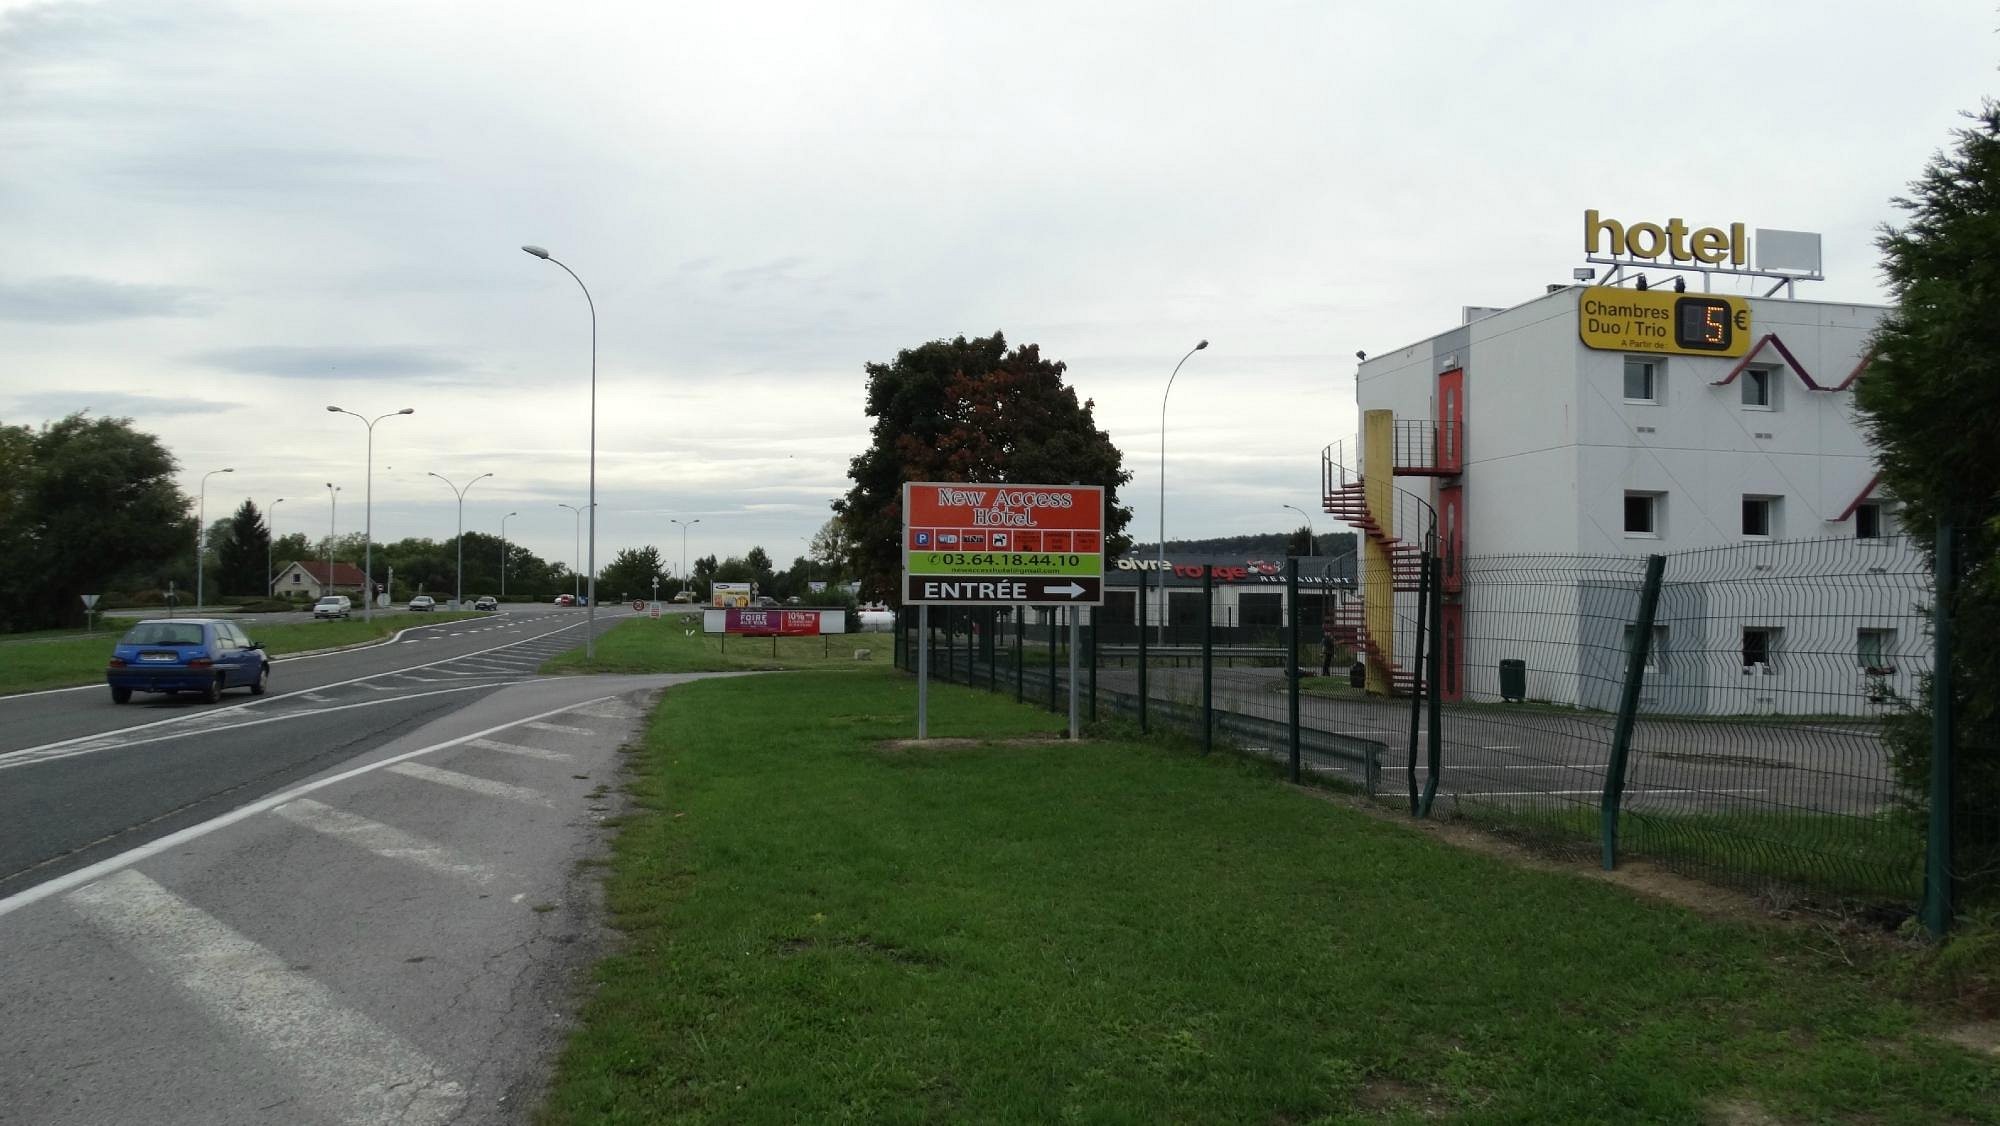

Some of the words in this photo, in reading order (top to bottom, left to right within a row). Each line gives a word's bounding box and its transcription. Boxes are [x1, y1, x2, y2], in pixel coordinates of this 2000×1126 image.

[1584, 209, 1745, 265] hotel
[1585, 300, 1669, 320] Chambres
[1588, 318, 1621, 336] Duo
[1634, 320, 1667, 337] Trio
[1706, 306, 1724, 343] 5
[1733, 309, 1748, 331] €
[937, 487, 986, 507] New
[994, 489, 1073, 508] Access
[973, 506, 1037, 527] Hôtel
[919, 534, 928, 544] P
[942, 553, 1080, 567] 03.64.18.44.10
[924, 579, 1027, 599] ENTRÉE
